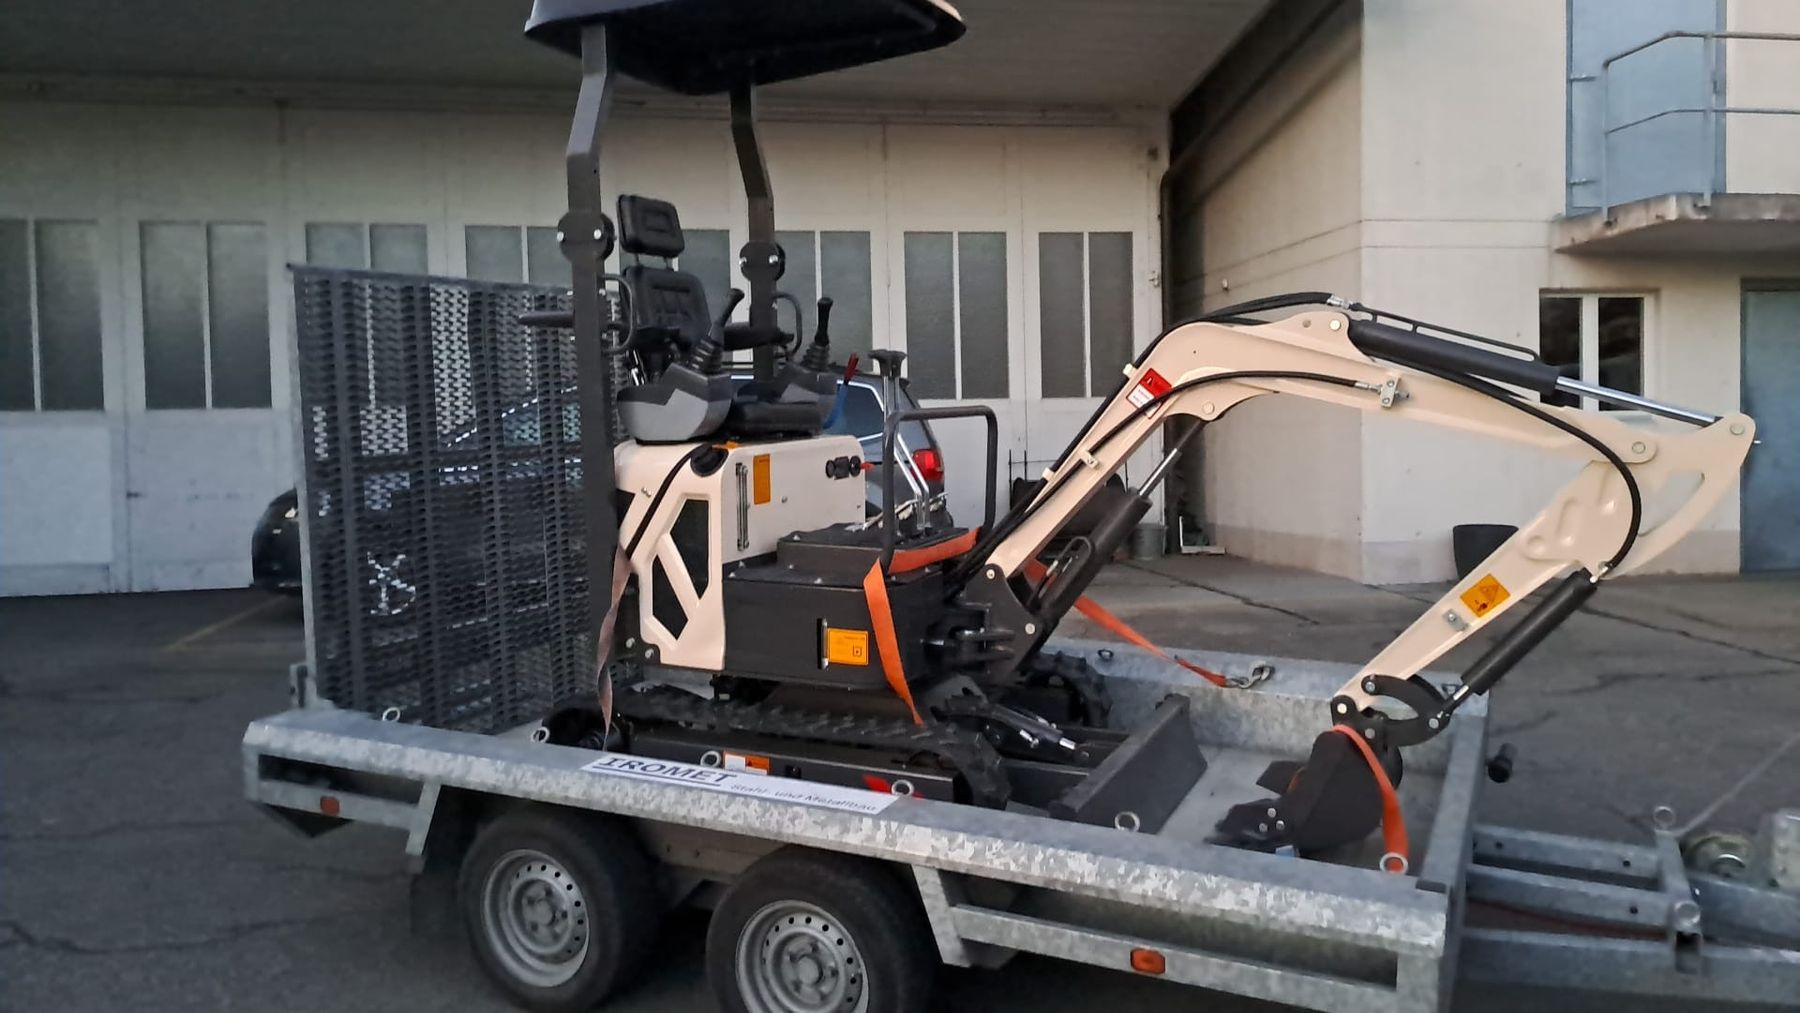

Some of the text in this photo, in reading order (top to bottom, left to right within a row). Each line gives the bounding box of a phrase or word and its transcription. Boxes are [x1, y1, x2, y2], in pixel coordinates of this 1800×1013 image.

[600, 756, 737, 783] IROMET
[775, 790, 802, 800] und
[804, 793, 876, 812] Metallbau
